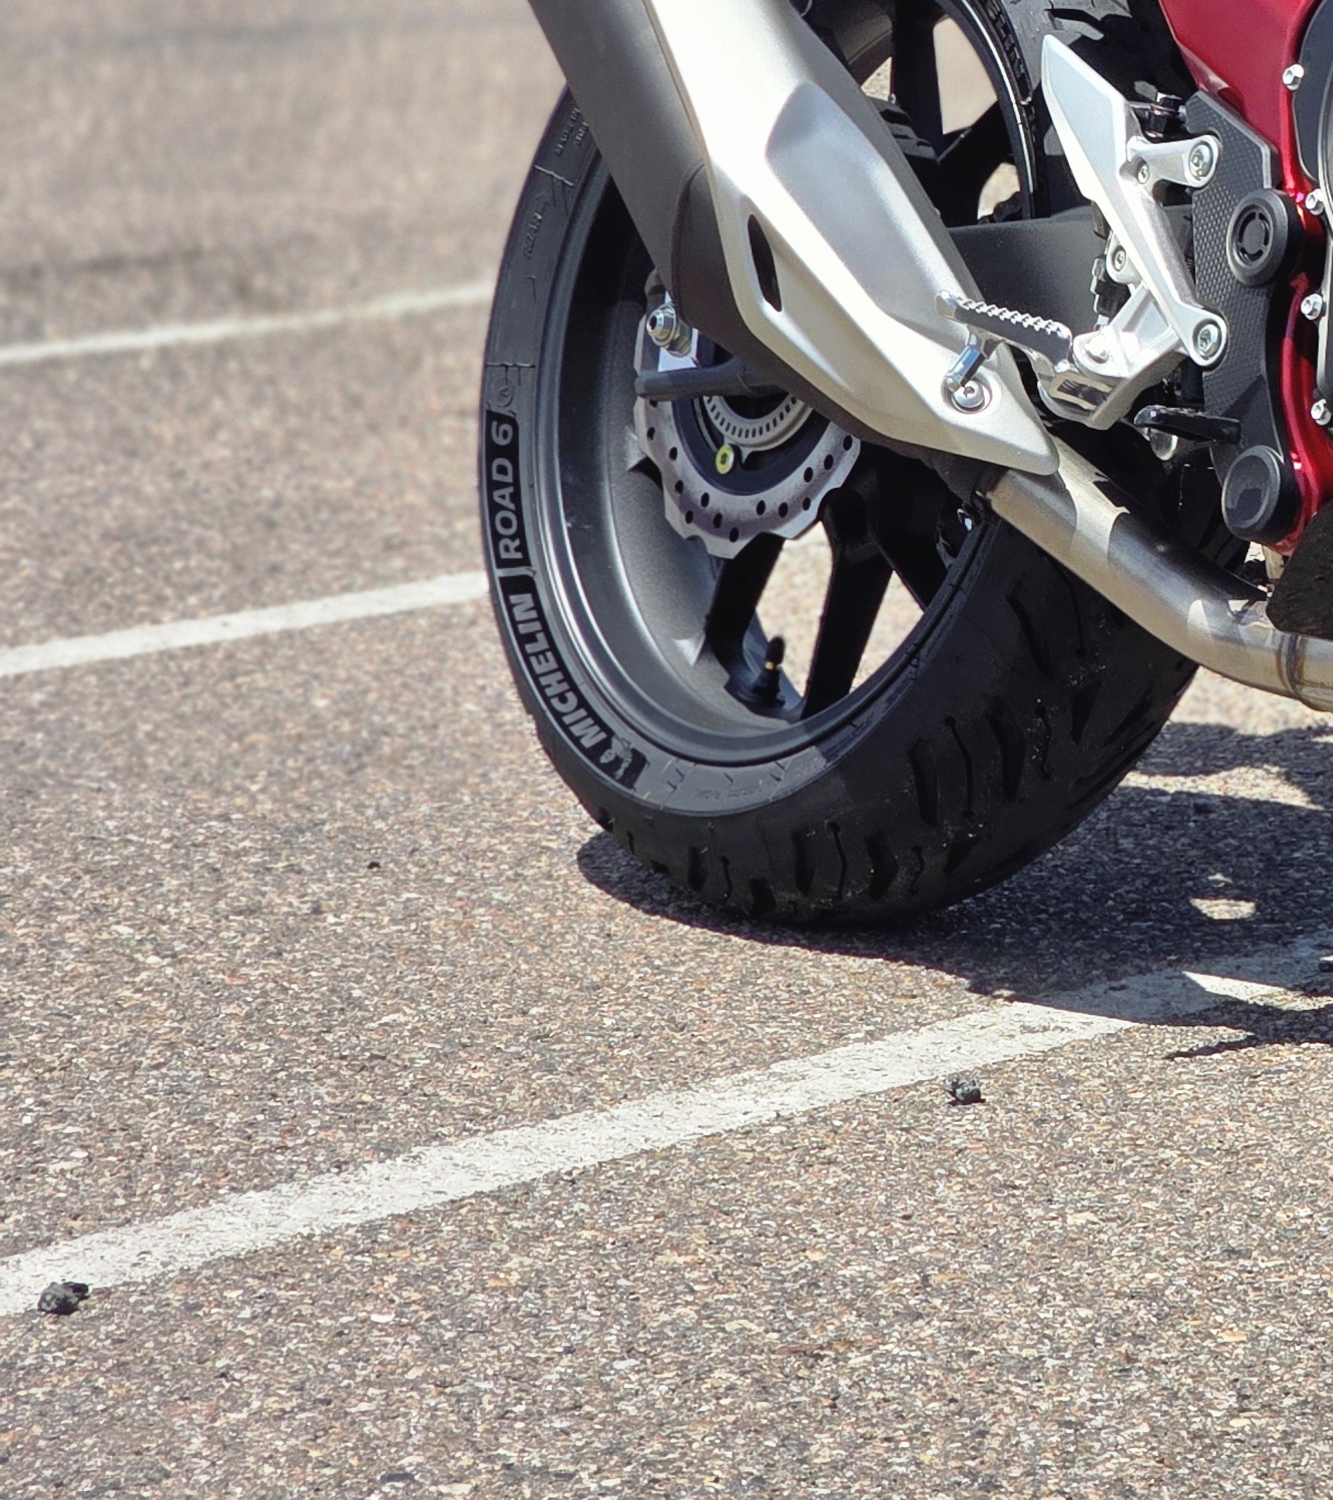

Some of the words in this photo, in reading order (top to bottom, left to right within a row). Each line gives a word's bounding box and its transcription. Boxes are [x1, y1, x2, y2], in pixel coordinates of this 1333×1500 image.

[490, 421, 514, 445] 6
[491, 456, 524, 560] ROAD
[508, 593, 602, 749] MICHELIN
